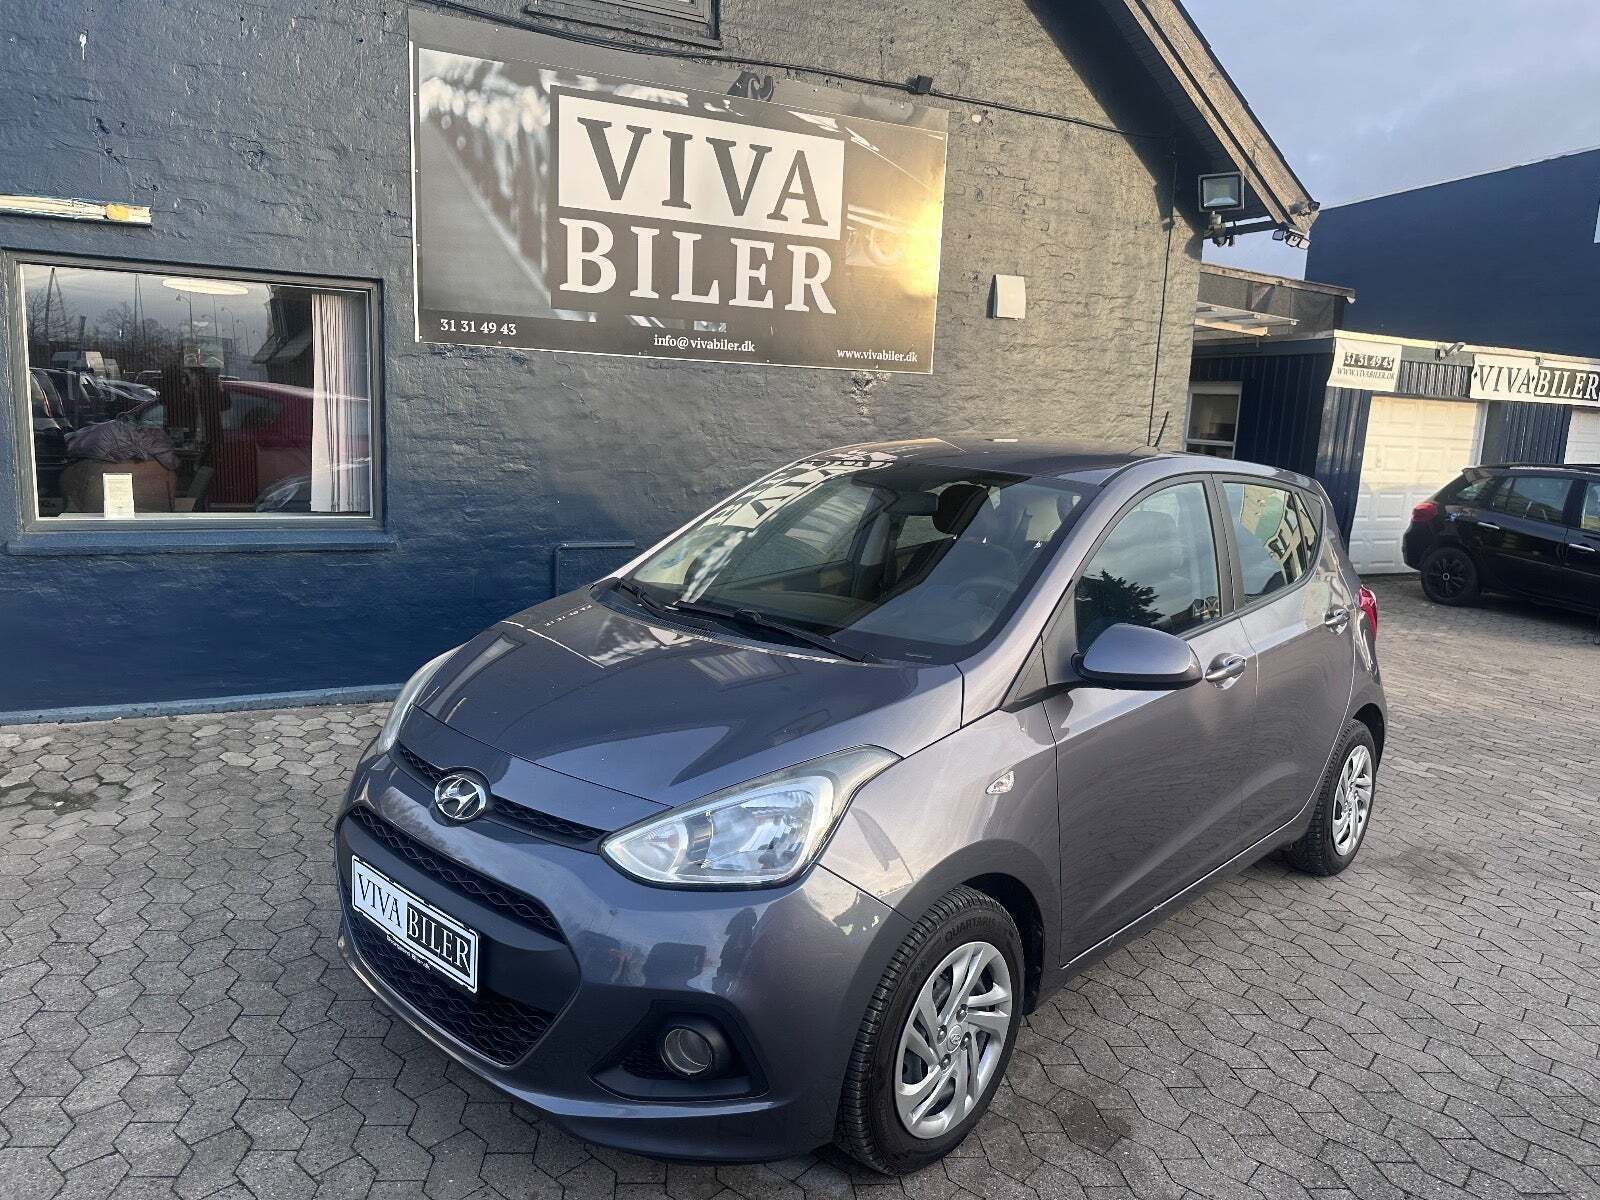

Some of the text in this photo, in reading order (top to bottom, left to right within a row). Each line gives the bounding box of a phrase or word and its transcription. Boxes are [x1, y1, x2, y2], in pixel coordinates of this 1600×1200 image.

[577, 117, 828, 226] VIVA
[558, 217, 837, 315] BILER
[440, 318, 517, 336] 31 31 49 43
[653, 333, 756, 353] info@vivabiler.dk
[836, 348, 918, 363] www.vivabiler.dk
[1478, 364, 1600, 401] VIVA BILER
[357, 872, 402, 929] VIVA
[407, 906, 471, 975] BILER
